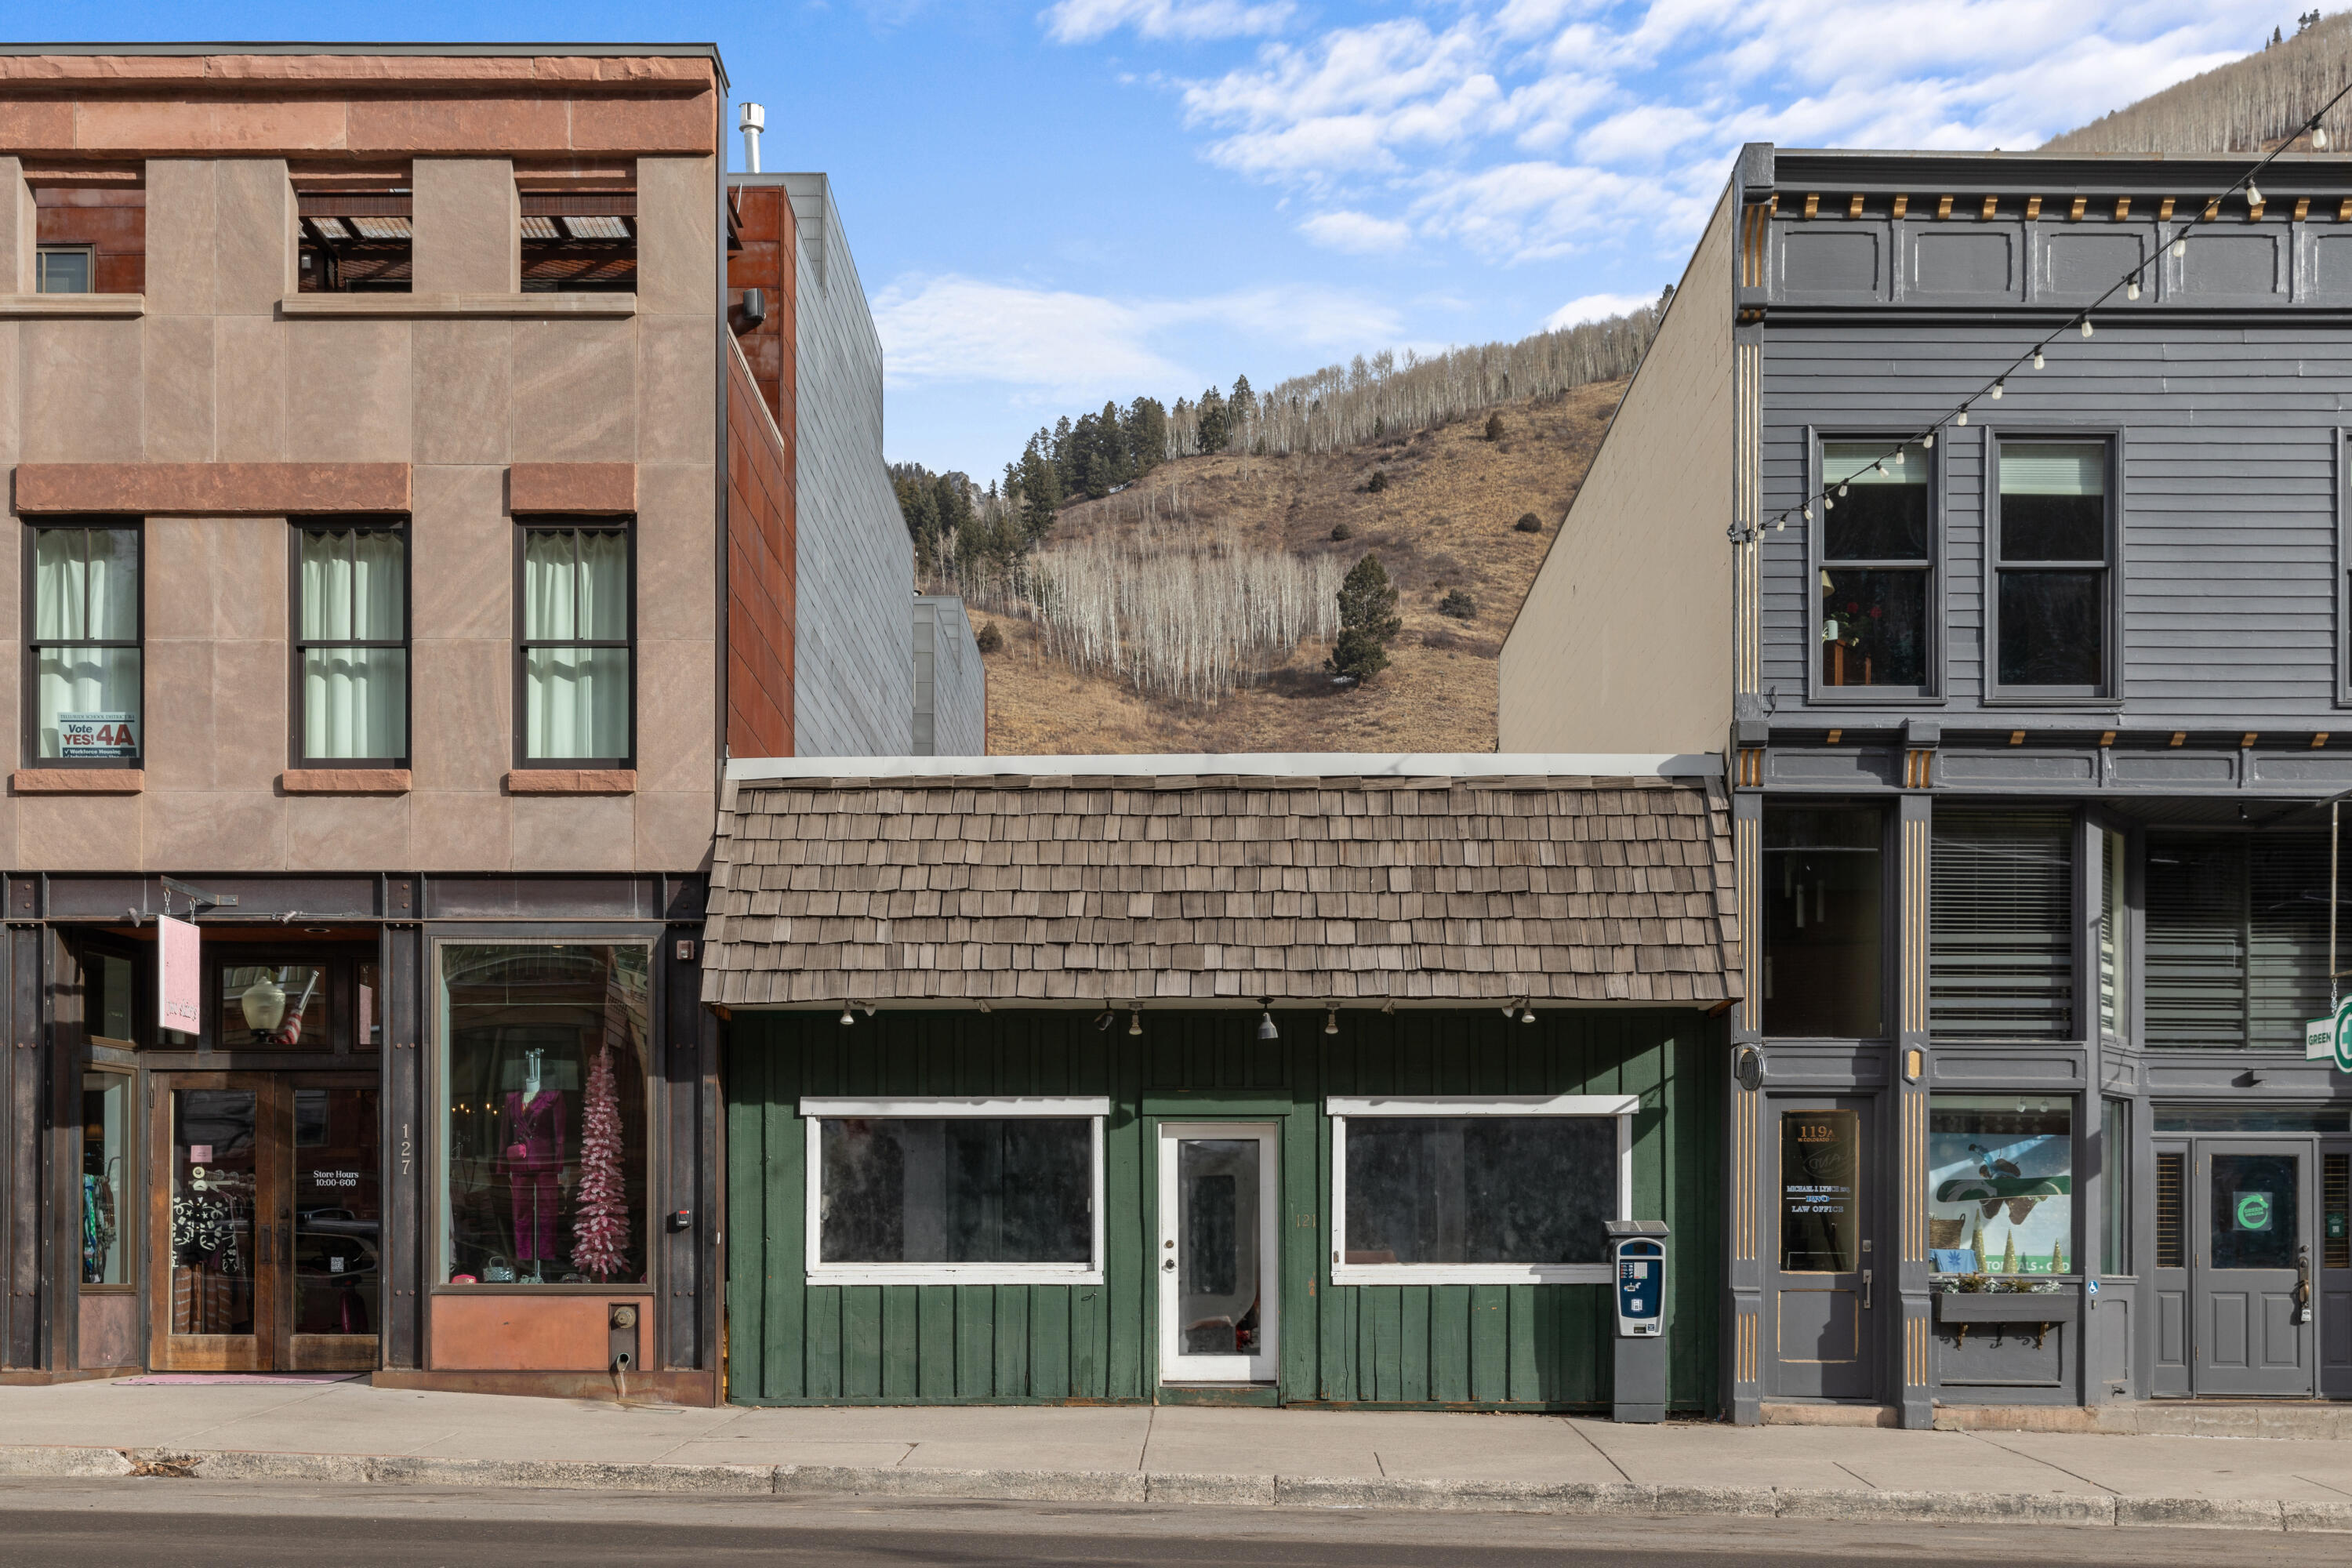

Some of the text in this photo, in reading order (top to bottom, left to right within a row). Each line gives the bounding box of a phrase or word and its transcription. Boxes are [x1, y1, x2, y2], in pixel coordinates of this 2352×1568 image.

[69, 724, 93, 733] Vote
[96, 724, 135, 746] 4A
[63, 734, 94, 745] YES!
[2308, 1032, 2332, 1045] GREEN
[401, 1123, 411, 1174] 127
[1296, 1214, 1316, 1229] 121
[2046, 1261, 2071, 1271] CD
